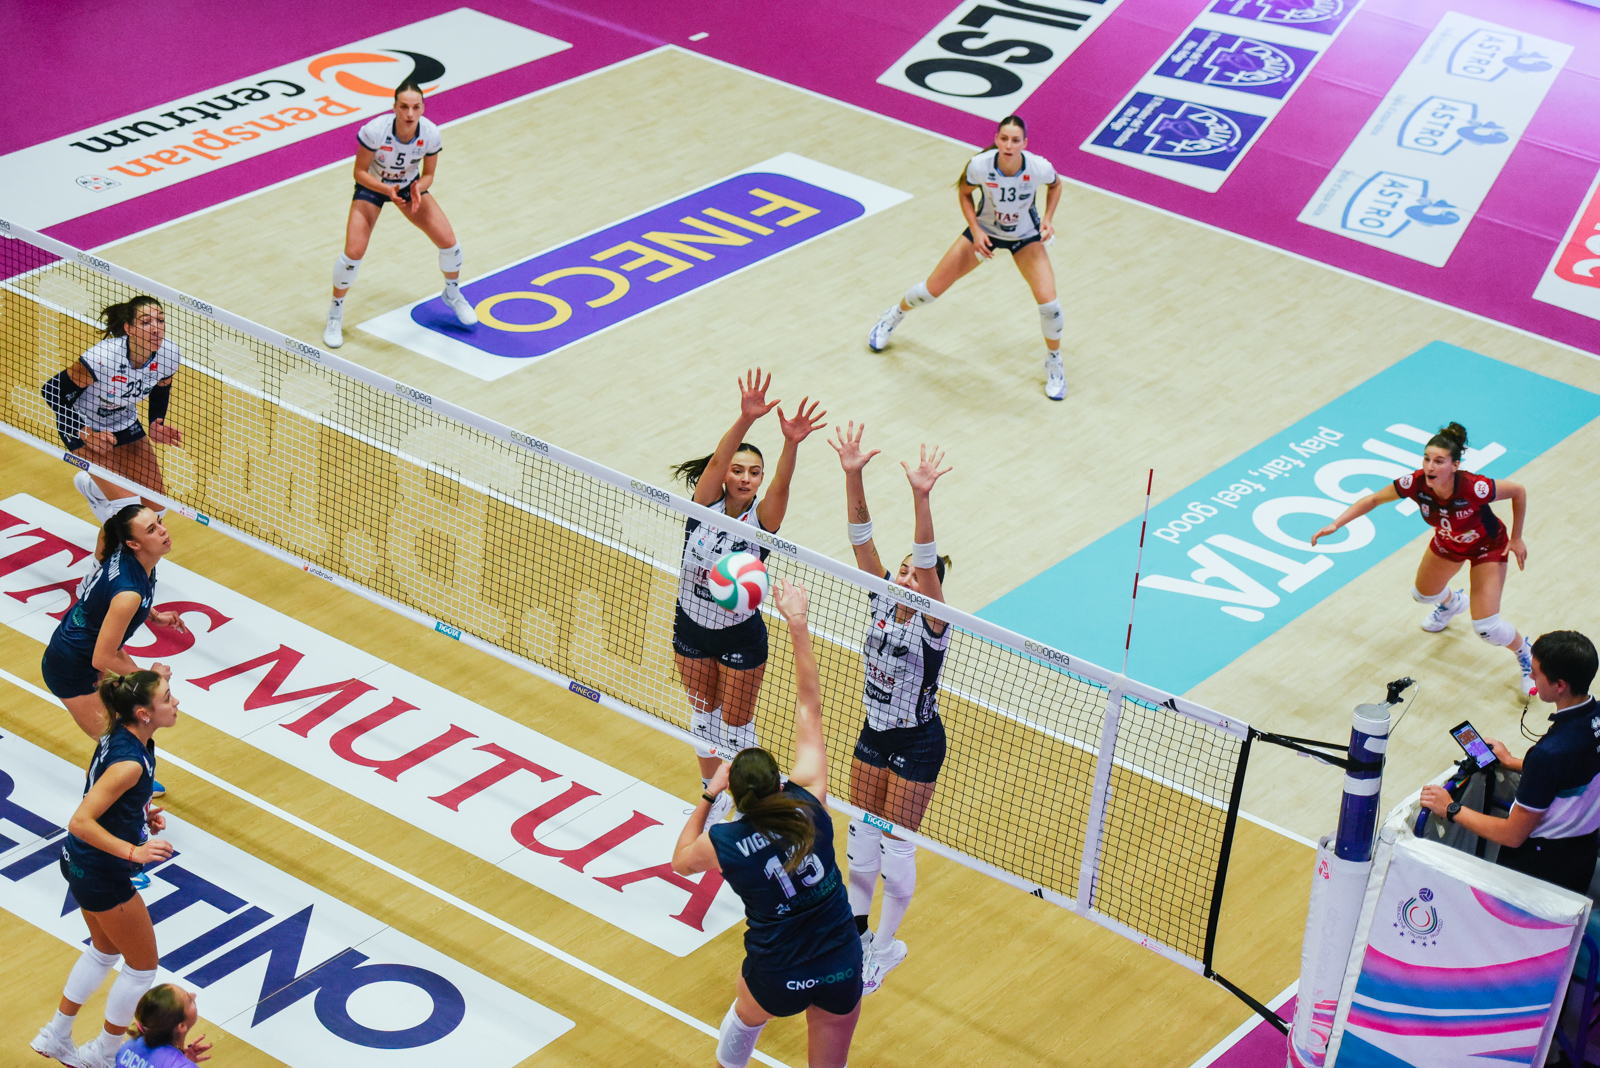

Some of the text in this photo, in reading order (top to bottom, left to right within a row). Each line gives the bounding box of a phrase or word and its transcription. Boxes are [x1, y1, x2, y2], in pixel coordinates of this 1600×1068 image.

[1462, 35, 1504, 75] ASTRO
[69, 79, 306, 153] Centrum
[1413, 102, 1460, 148] ASTRO
[107, 95, 362, 178] Pensplan
[395, 152, 406, 166] 5
[999, 186, 1017, 203] 13
[1358, 178, 1410, 229] ASTRO
[474, 187, 822, 333] FINECO
[121, 379, 143, 398] 23
[395, 382, 432, 405] ecoopera
[510, 430, 548, 453] ecoopera
[65, 454, 88, 470] FINECO
[630, 479, 670, 503] ecoopera
[1152, 426, 1345, 545] play fair, feel good
[1455, 508, 1474, 518] ITAS
[755, 530, 797, 555] ecoopera
[309, 567, 334, 582] unobravo
[887, 584, 931, 609] ecoopera
[1024, 639, 1070, 666] ecoopera
[571, 683, 599, 701] FINECO
[186, 643, 725, 932] MUTUA
